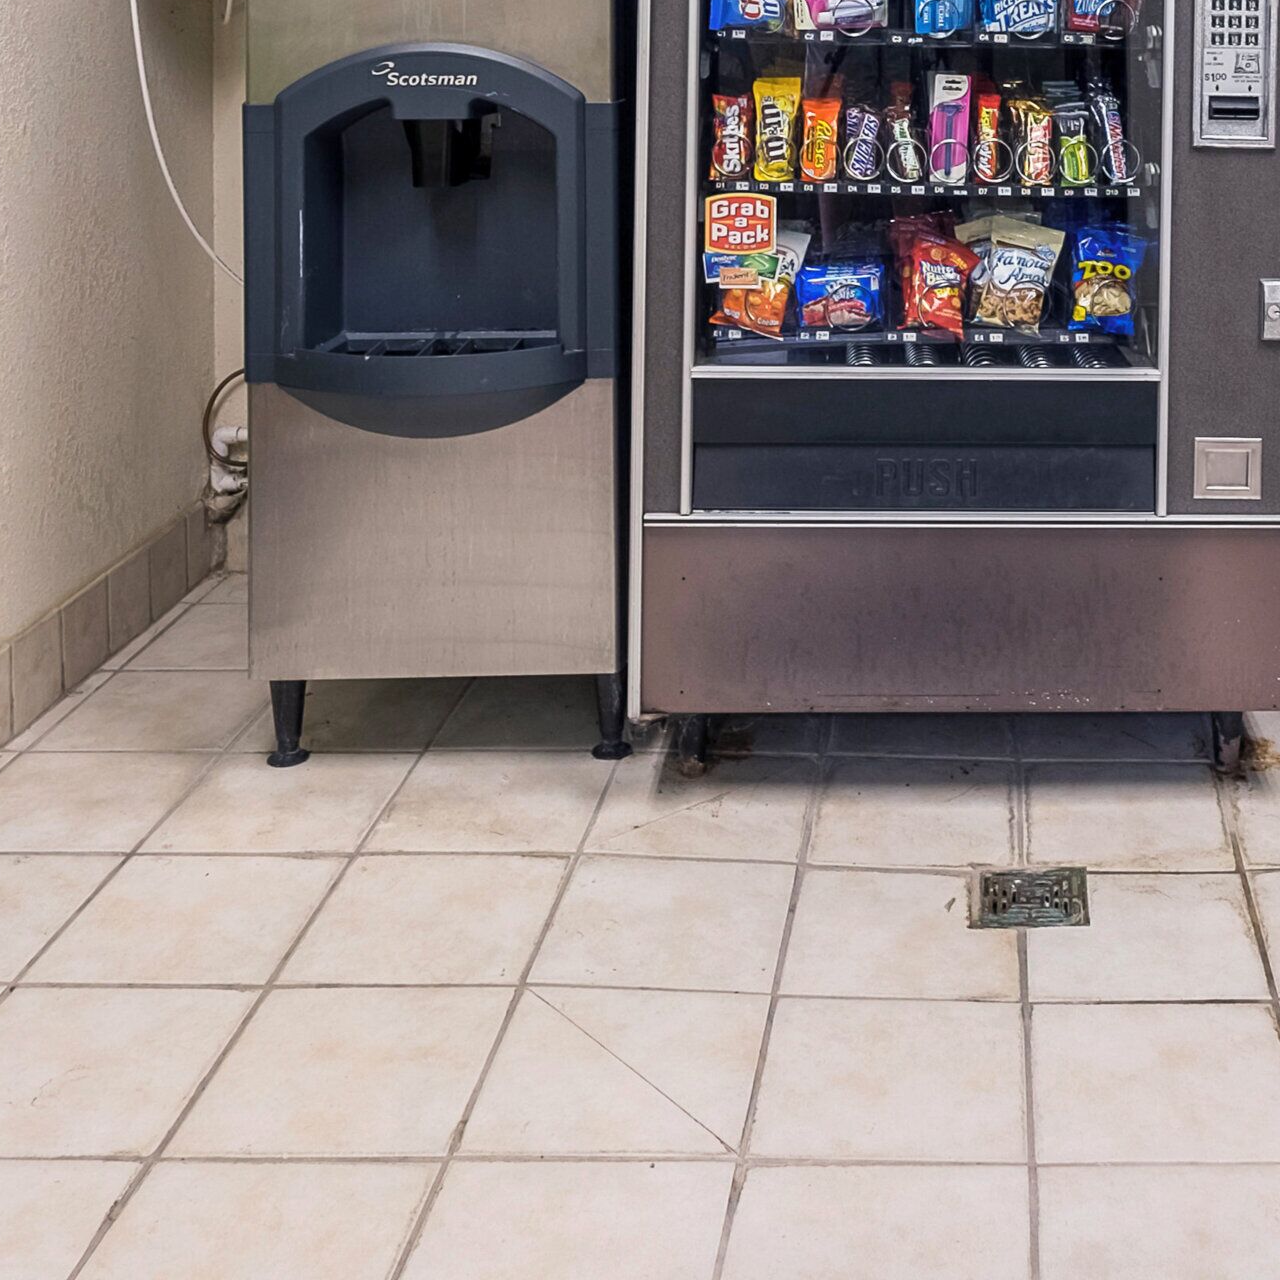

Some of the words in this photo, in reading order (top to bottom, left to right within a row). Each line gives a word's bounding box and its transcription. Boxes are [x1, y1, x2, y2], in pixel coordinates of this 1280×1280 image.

[1063, 34, 1074, 42] C5
[386, 71, 477, 86] Scotsman
[850, 114, 880, 176] SNICKERS
[978, 187, 988, 195] D7
[711, 199, 770, 219] Grab
[734, 216, 748, 228] a
[711, 222, 770, 244] Pack
[875, 458, 978, 497] PUSH
